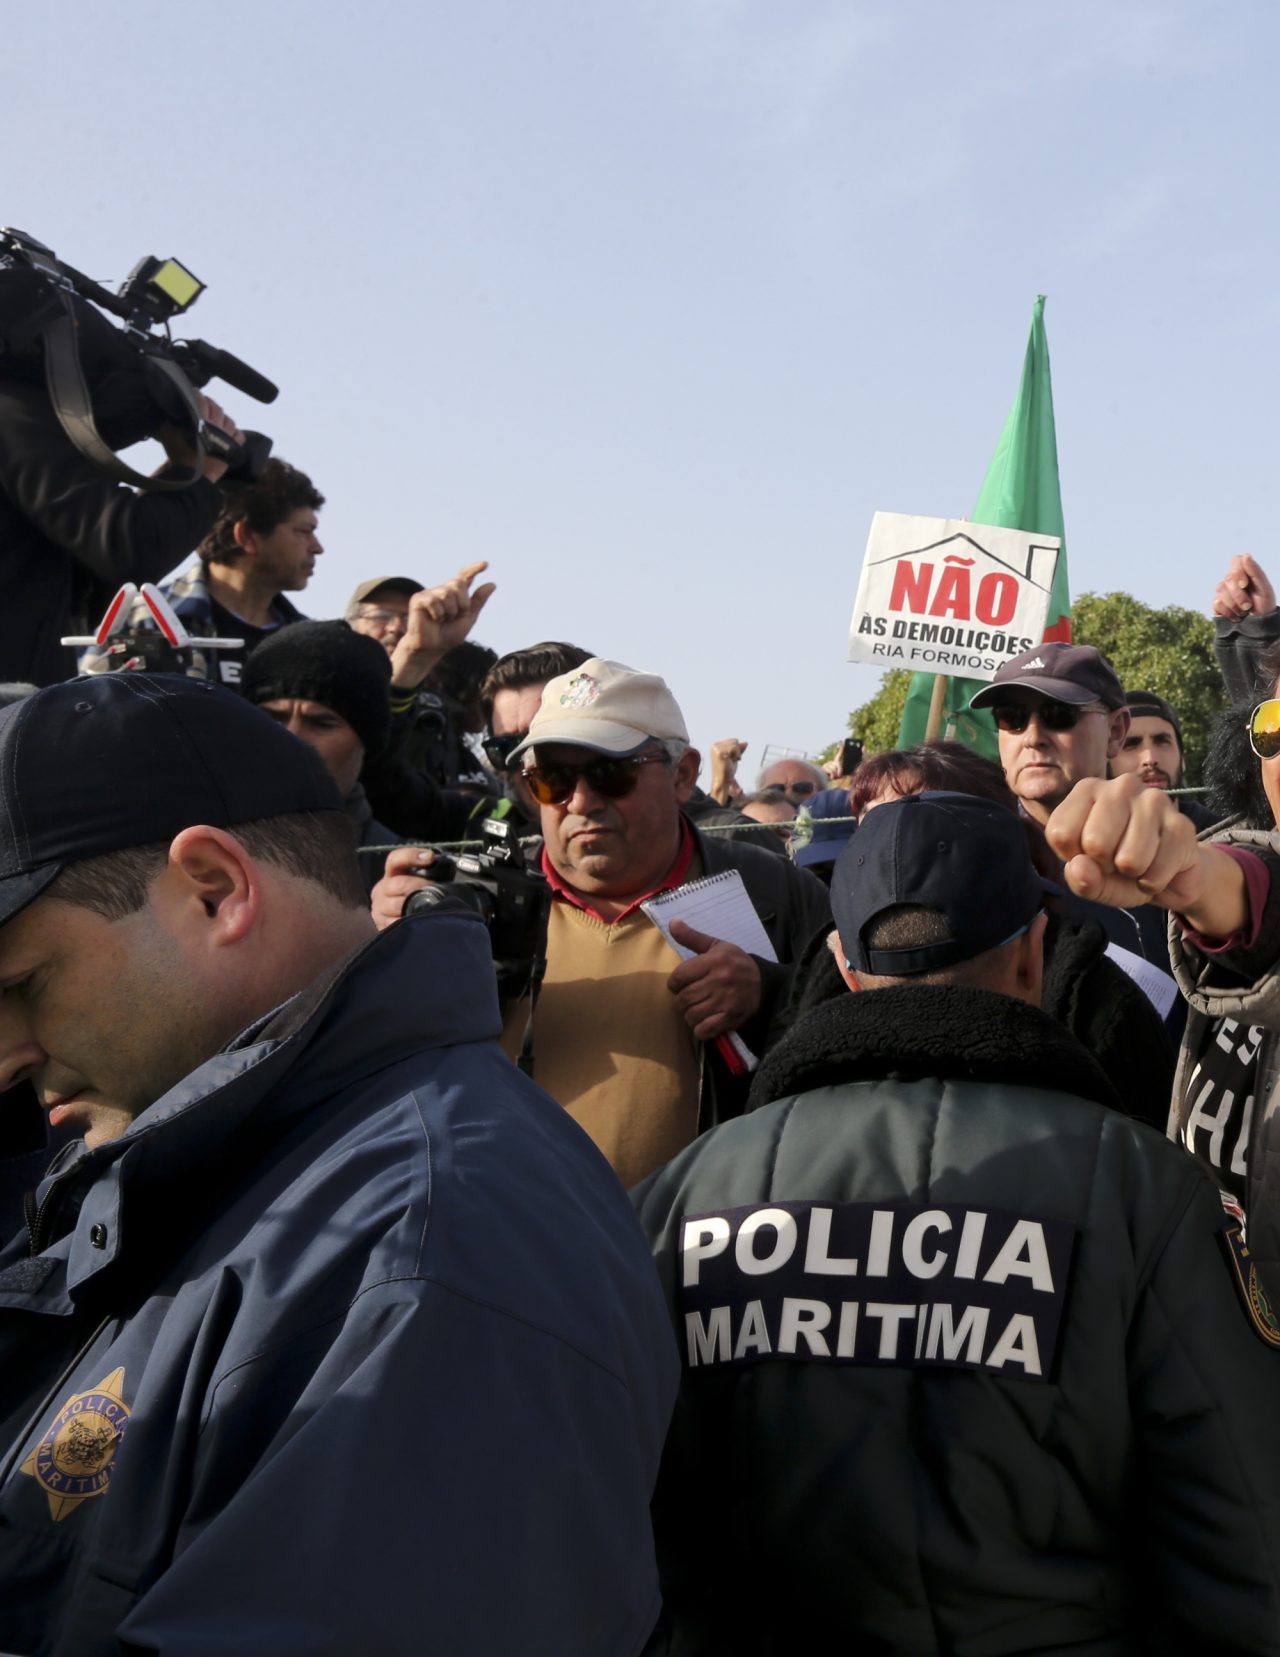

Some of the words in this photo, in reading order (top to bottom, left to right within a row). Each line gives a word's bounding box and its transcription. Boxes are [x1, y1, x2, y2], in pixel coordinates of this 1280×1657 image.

[888, 554, 1020, 627] NÃO
[858, 611, 888, 637] ÀS
[892, 618, 1034, 655] DEMOLIÇÕES
[872, 642, 905, 659] RIA
[682, 1206, 1055, 1294] POLICIA
[684, 1297, 1043, 1376] MARITIMA
